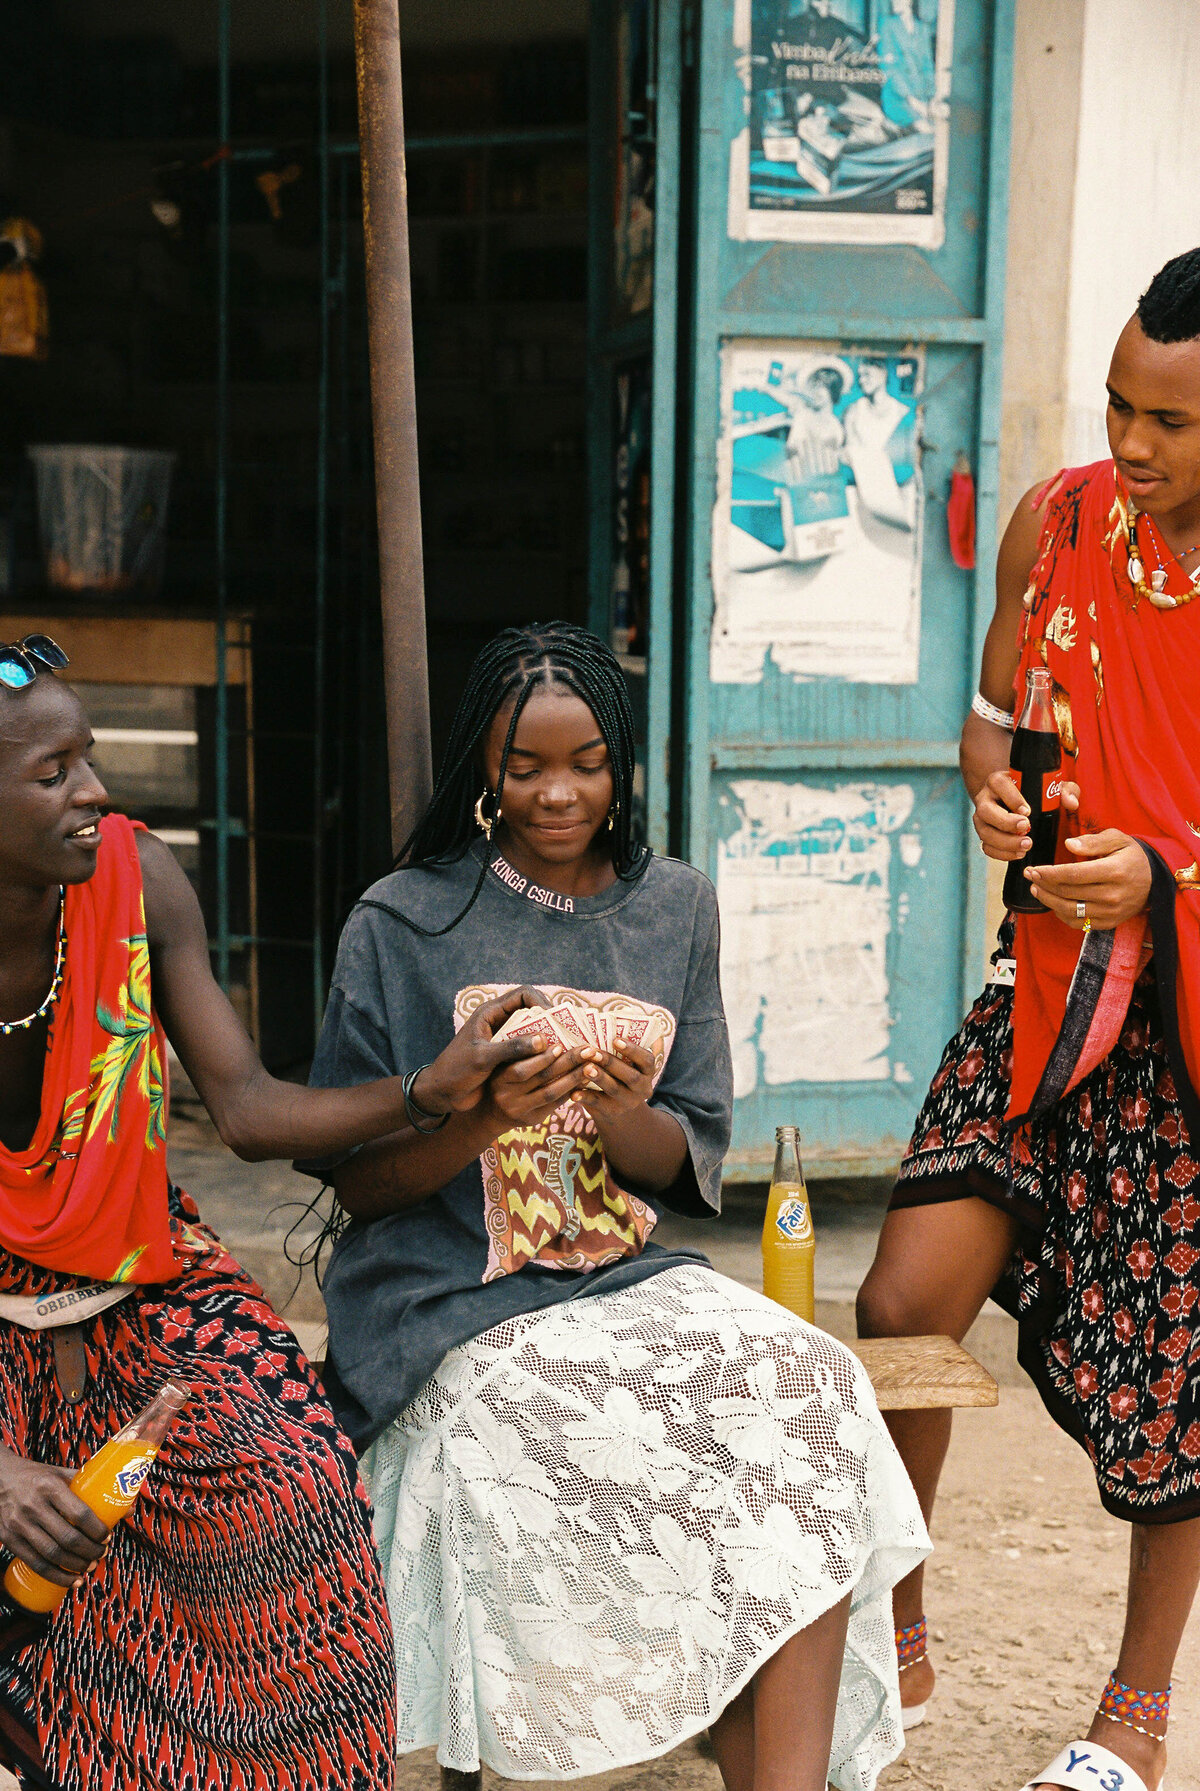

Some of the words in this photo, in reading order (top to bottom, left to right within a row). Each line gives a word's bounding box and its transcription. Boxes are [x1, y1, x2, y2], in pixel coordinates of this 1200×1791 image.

[490, 856, 527, 894] KINGA
[527, 885, 575, 914] CSILLA
[1065, 1749, 1124, 1791] Y-3
